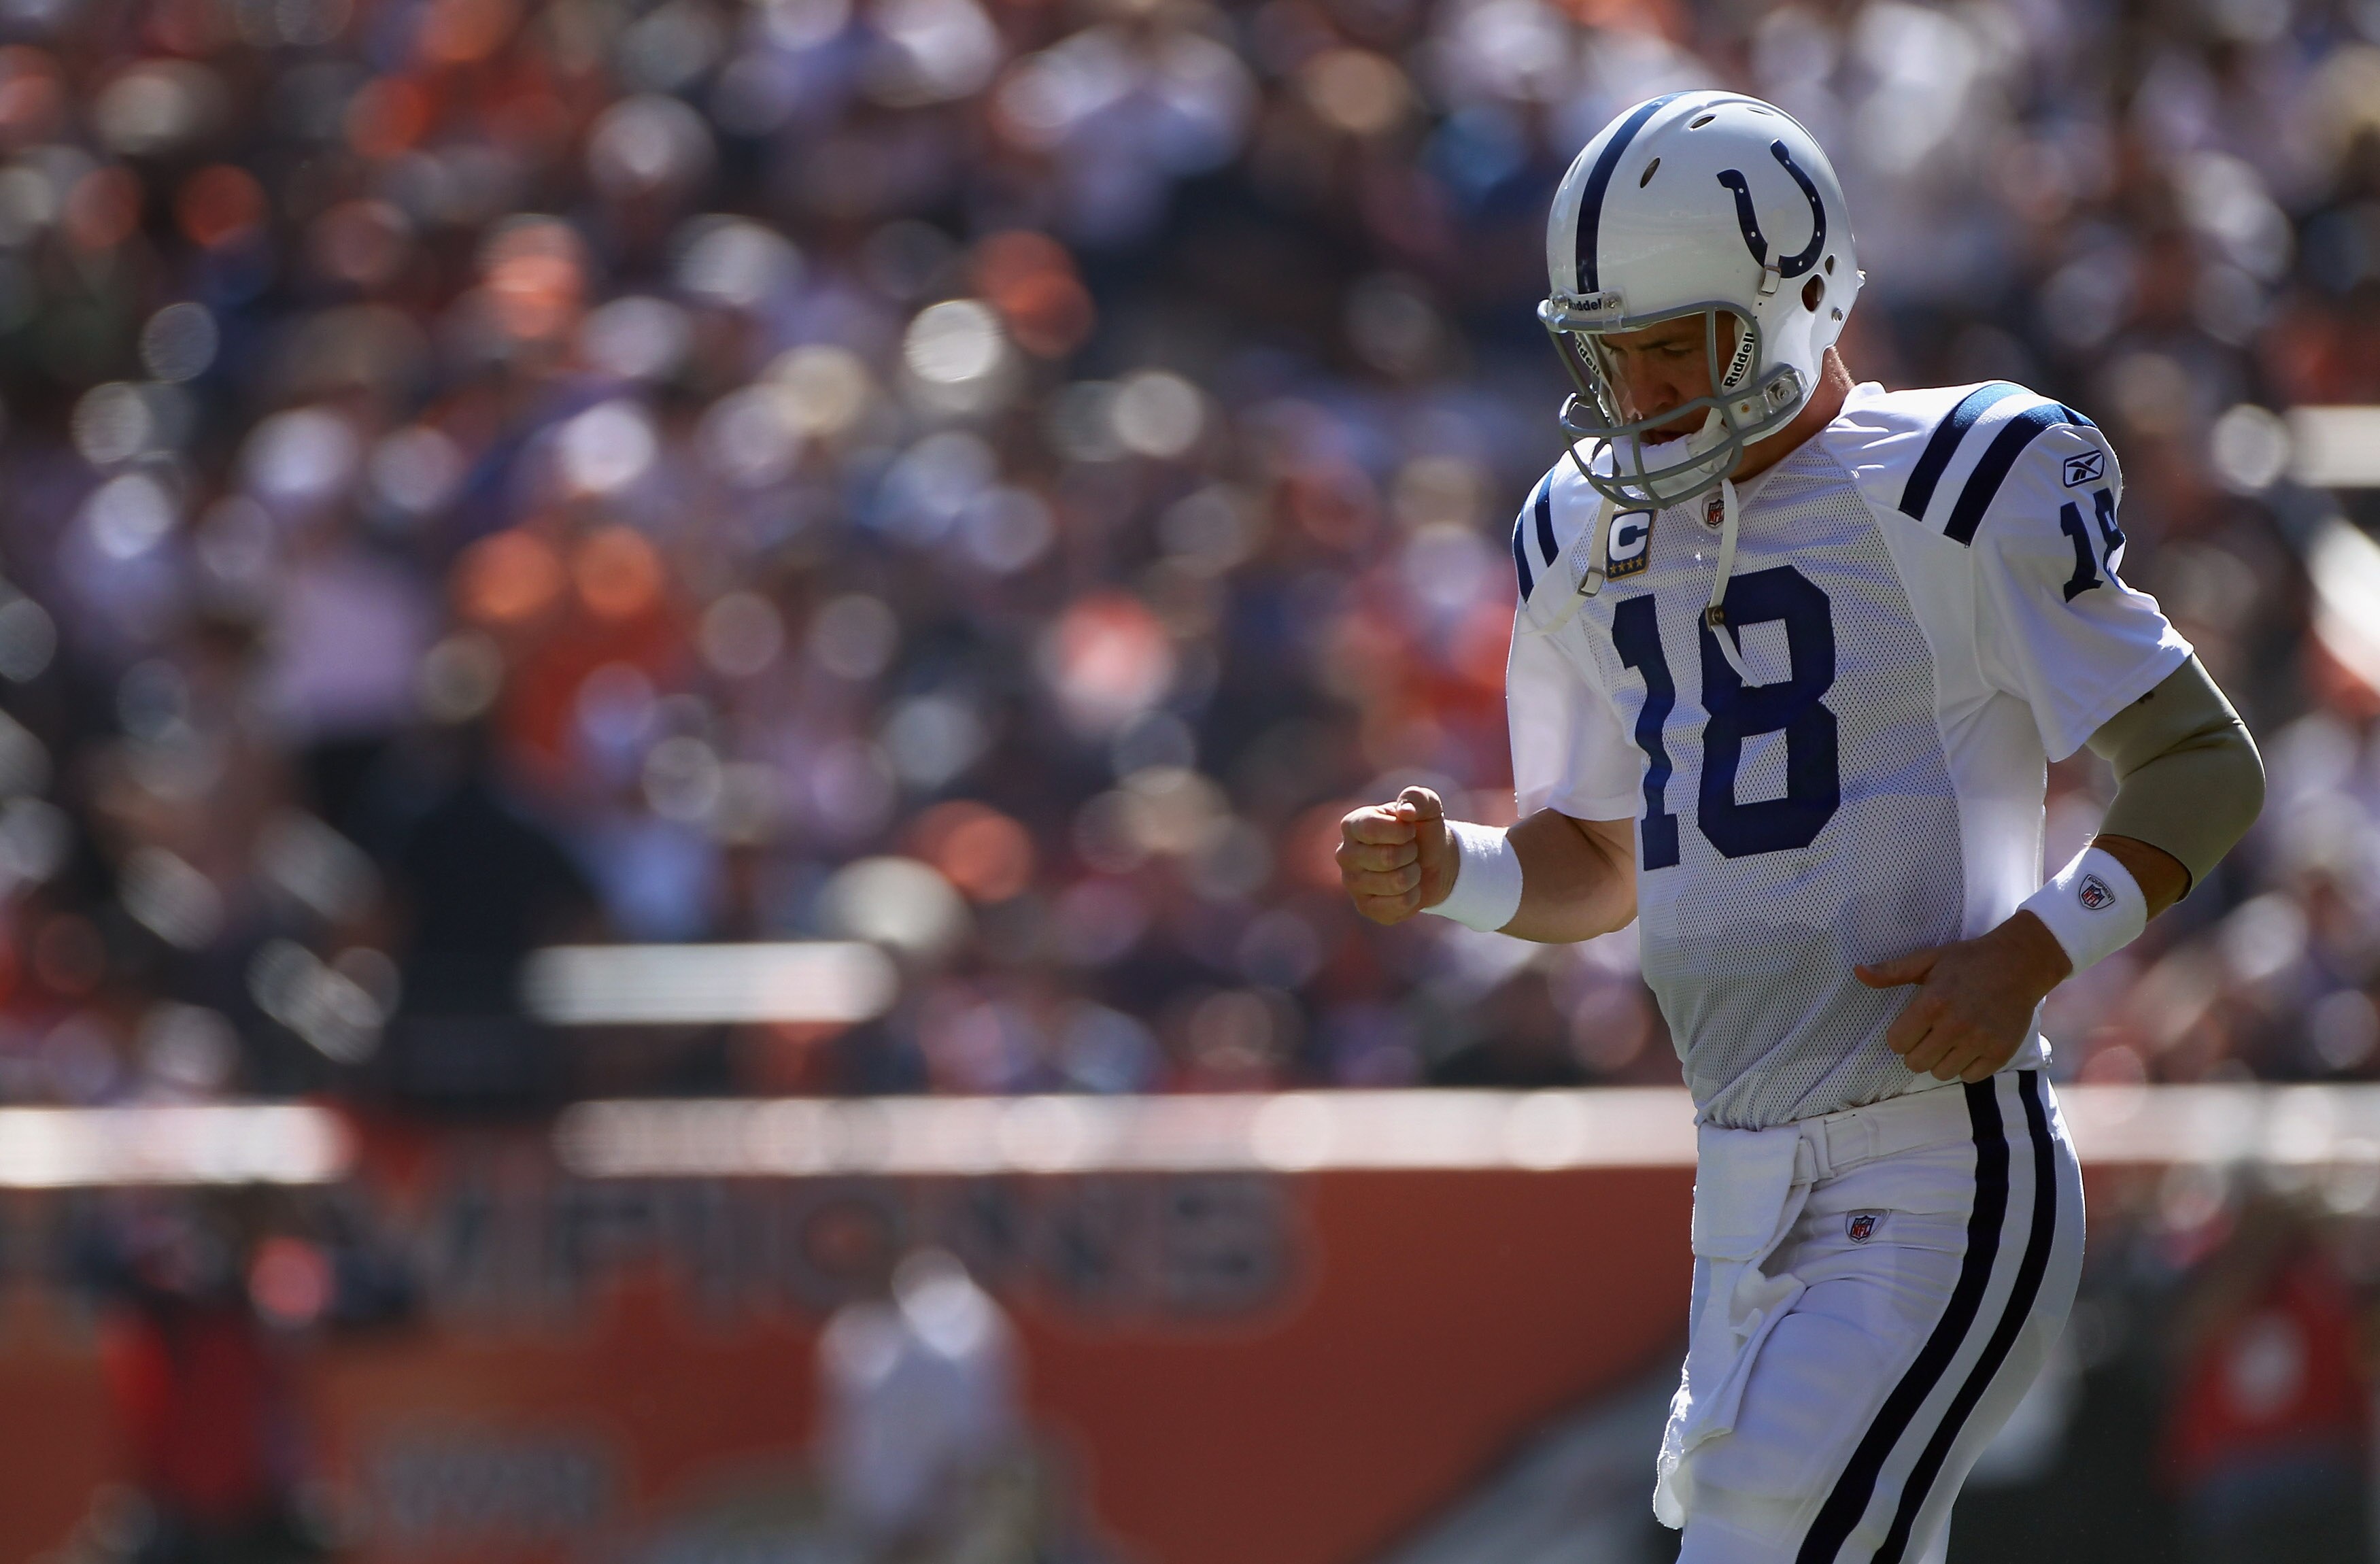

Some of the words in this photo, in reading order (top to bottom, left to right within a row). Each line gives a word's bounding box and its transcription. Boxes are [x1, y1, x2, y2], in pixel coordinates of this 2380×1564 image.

[1567, 298, 1602, 311] Riddel
[1723, 332, 1755, 388] Riddell
[1608, 511, 1650, 561] C
[1612, 564, 1841, 871] 18
[2082, 890, 2098, 908] NFL
[1852, 1224, 1870, 1238] NFL
